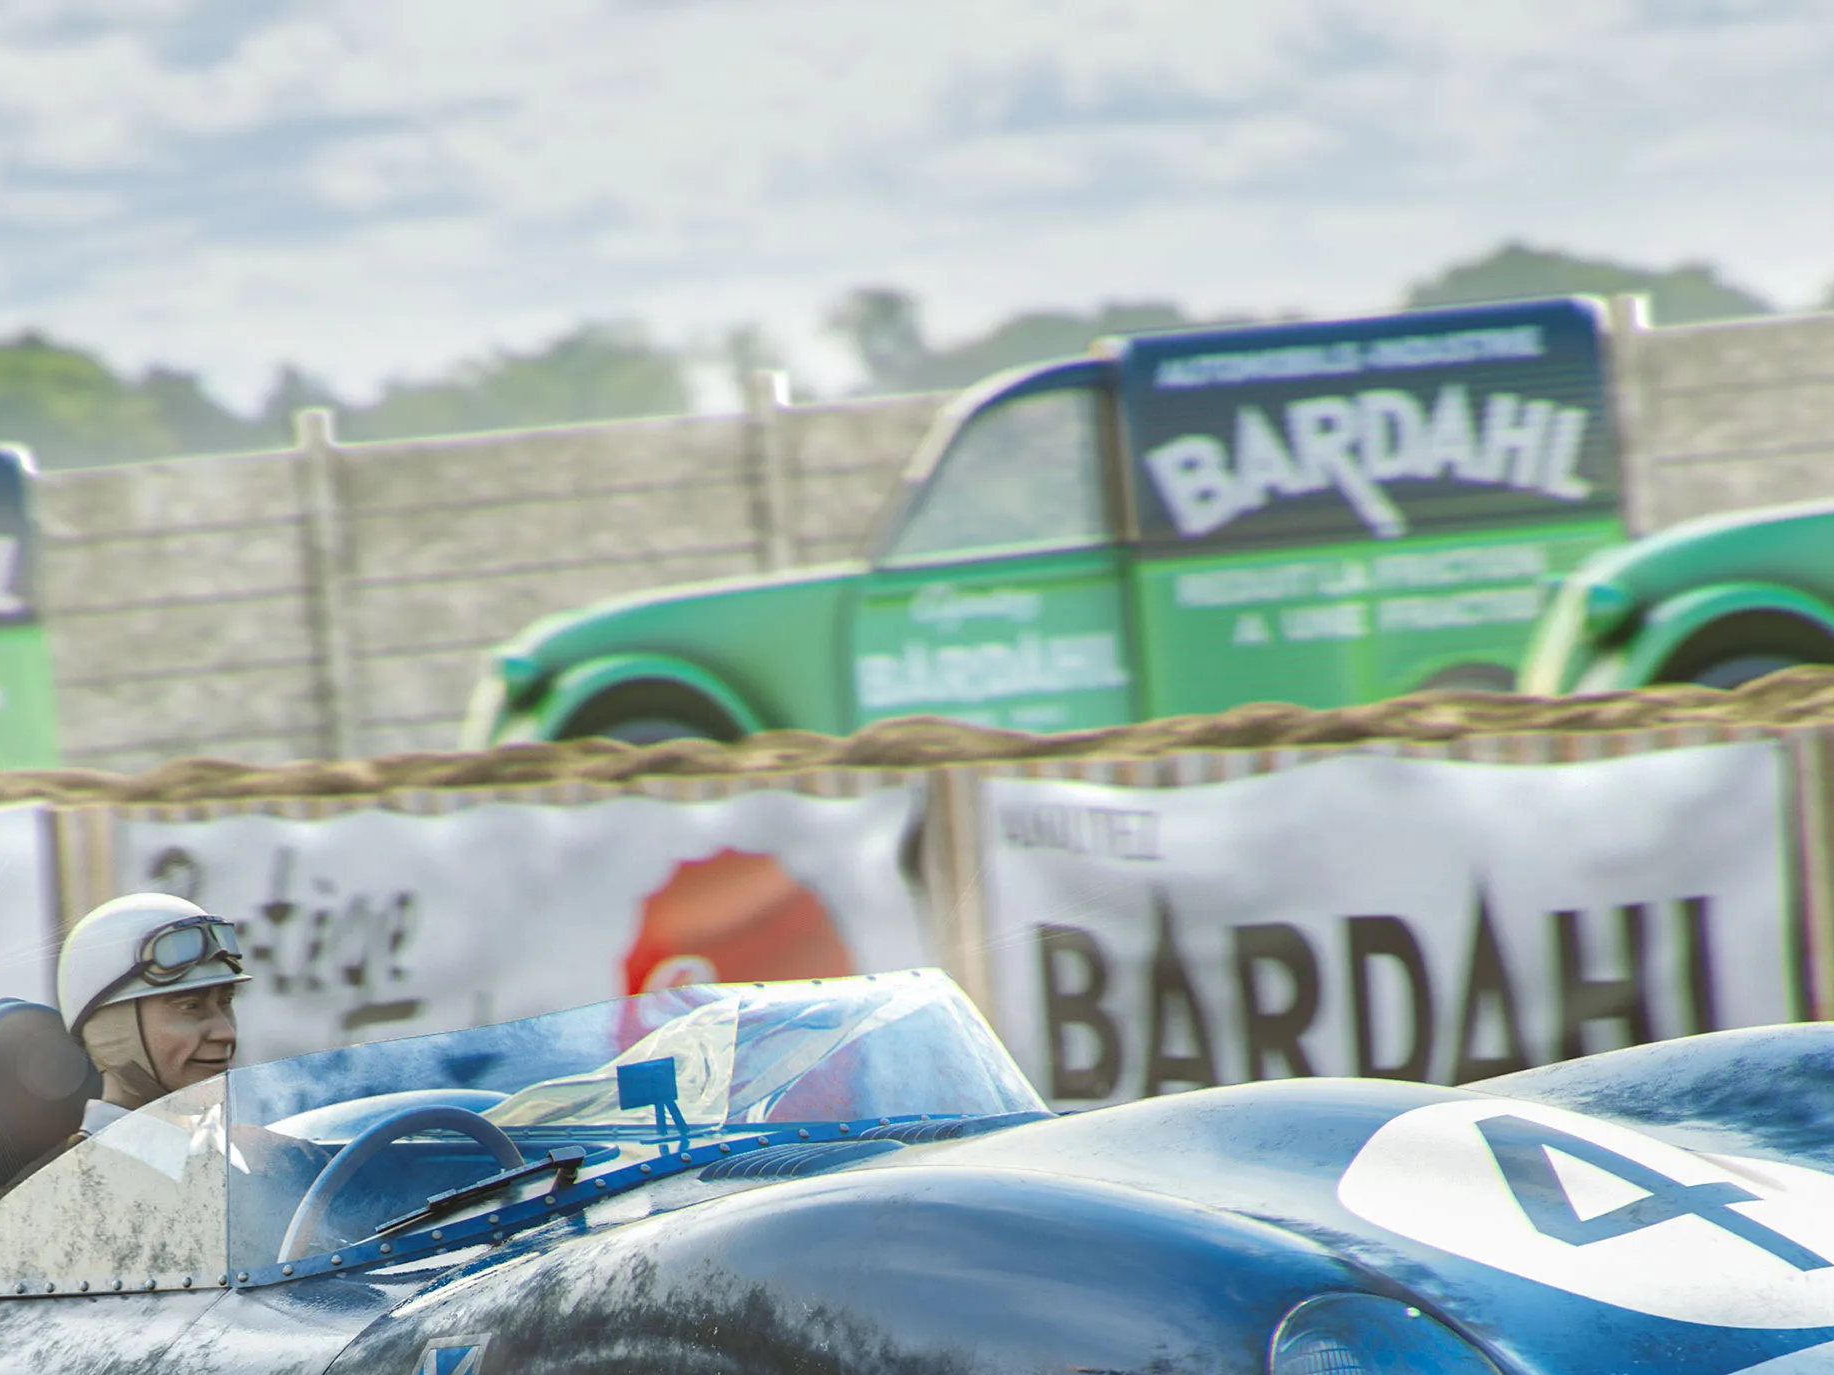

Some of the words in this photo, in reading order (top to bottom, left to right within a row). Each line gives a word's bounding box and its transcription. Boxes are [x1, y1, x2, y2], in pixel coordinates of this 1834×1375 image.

[1146, 385, 1590, 538] BARDAHL
[857, 631, 1131, 709] BARDAHL
[1475, 1114, 1834, 1271] 4
